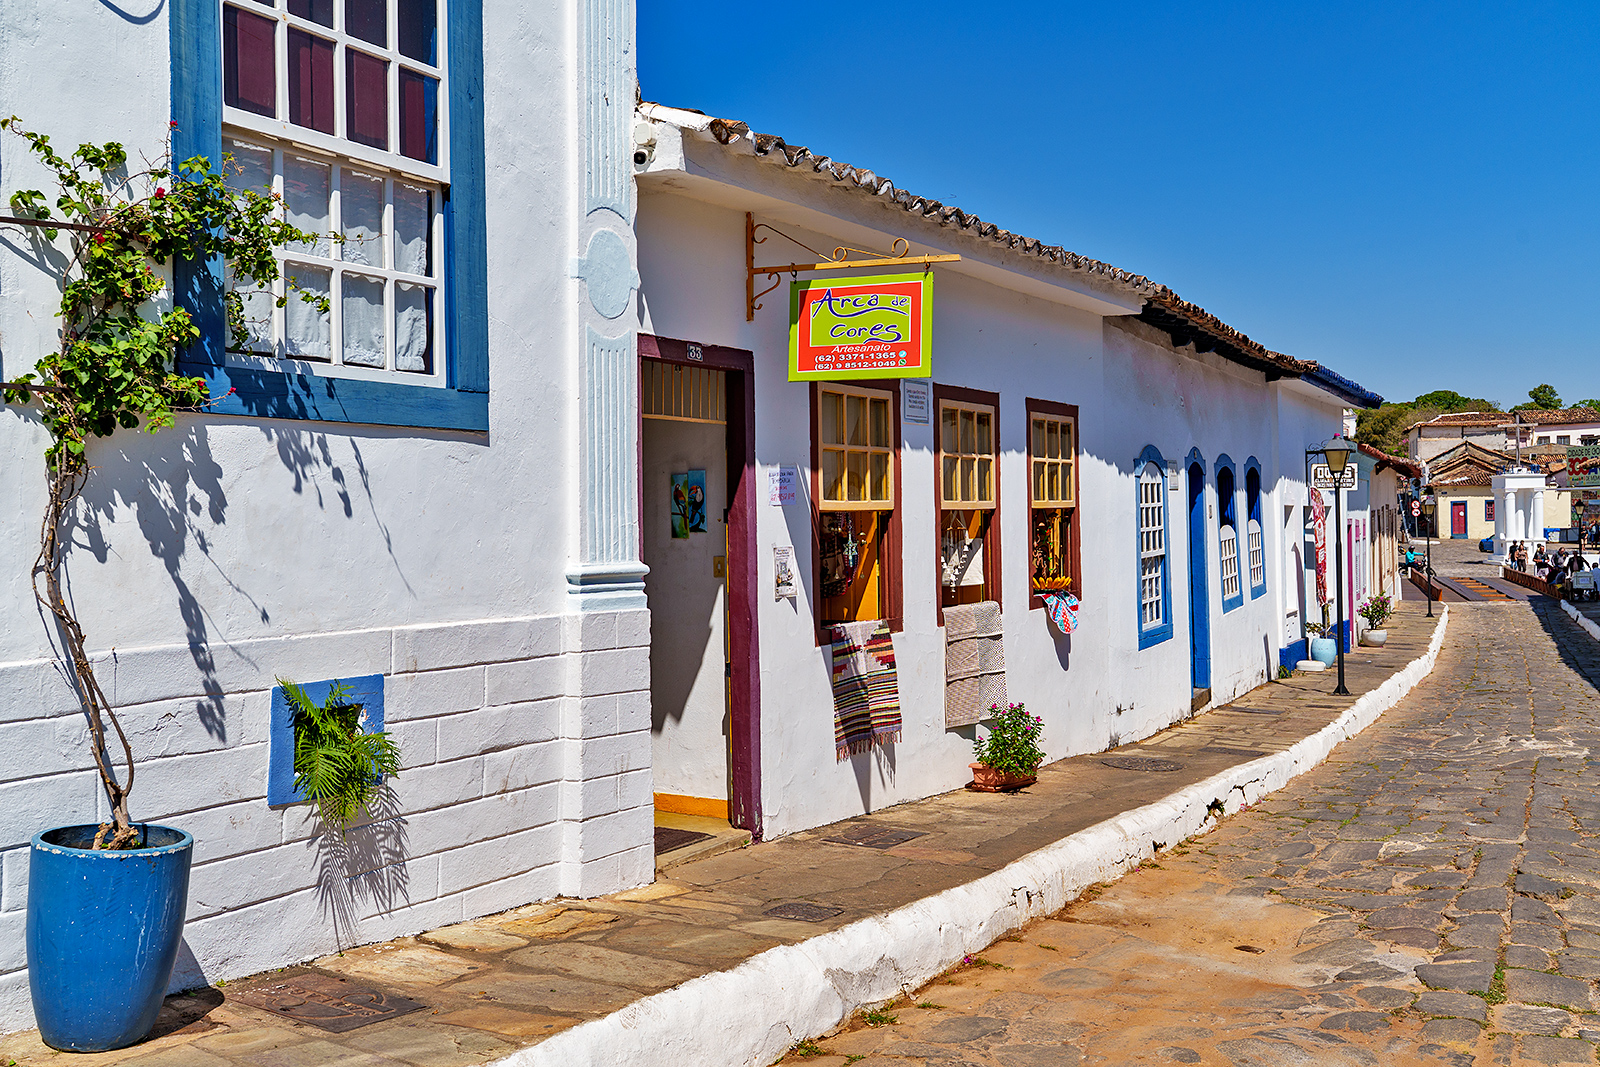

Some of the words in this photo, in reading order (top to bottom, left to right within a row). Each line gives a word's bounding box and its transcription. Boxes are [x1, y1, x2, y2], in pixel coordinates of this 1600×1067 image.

[811, 288, 879, 318] Arca
[891, 296, 909, 306] de
[830, 323, 902, 344] Cores
[689, 345, 702, 359] 33
[831, 344, 891, 353] Artesanato
[814, 354, 836, 363] (62)
[839, 352, 896, 360] 3371-1365
[814, 363, 834, 371] (62)
[844, 360, 896, 368] 8512-1049
[1585, 448, 1590, 456] DE
